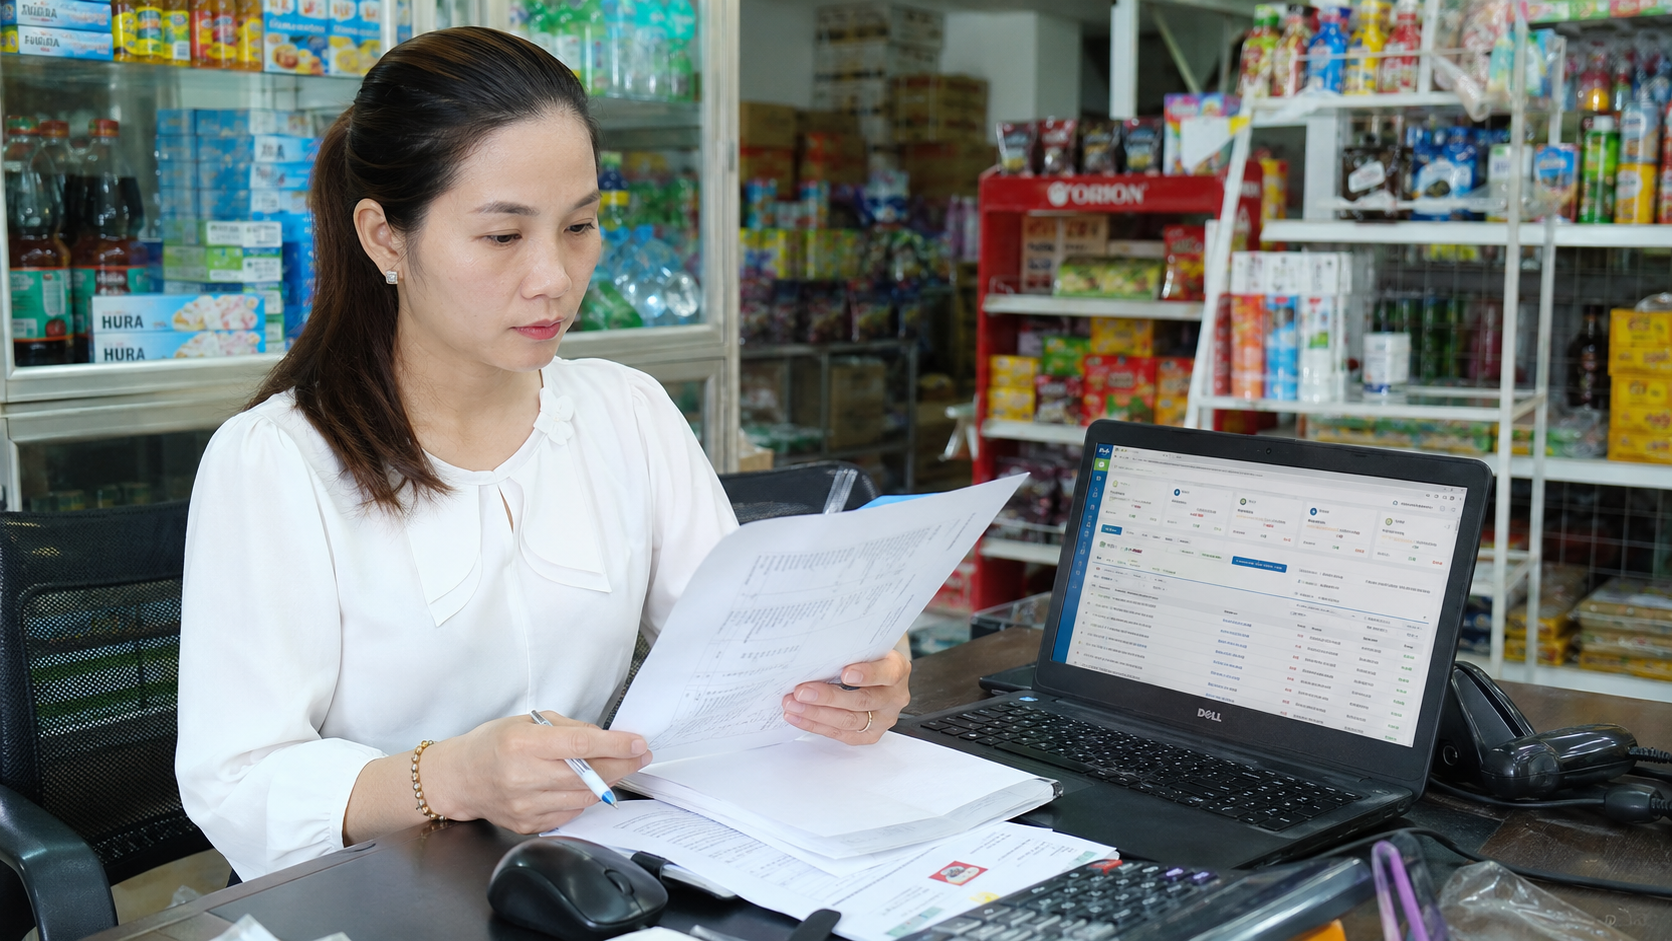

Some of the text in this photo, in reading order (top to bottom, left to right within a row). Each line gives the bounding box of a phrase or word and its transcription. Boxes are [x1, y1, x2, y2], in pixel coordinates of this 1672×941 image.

[1070, 182, 1144, 206] ORION
[102, 315, 144, 329] HURA
[104, 347, 145, 361] HURA
[1197, 708, 1222, 722] DELL
